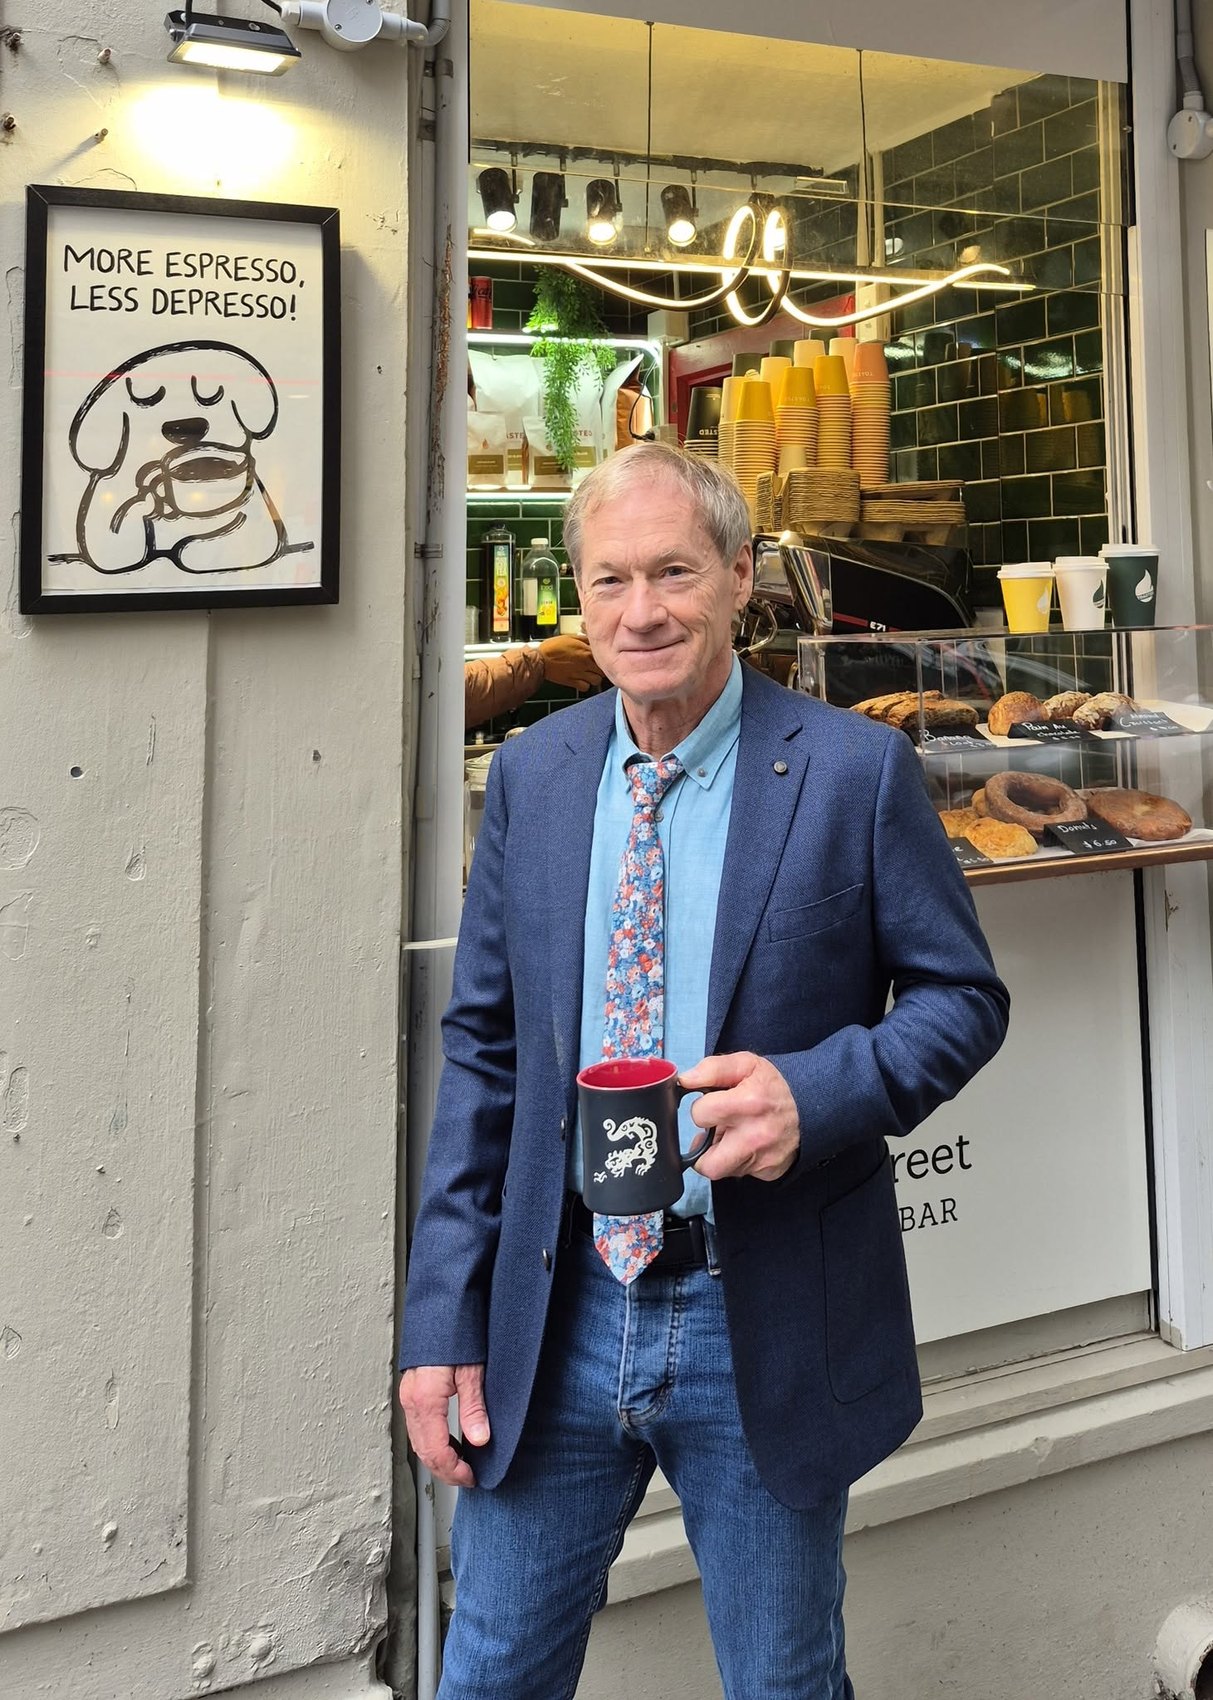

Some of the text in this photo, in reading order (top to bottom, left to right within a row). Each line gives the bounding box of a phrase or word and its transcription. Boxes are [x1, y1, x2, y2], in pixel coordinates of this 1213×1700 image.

[64, 244, 305, 288] MORE ESPRESSO,
[70, 284, 296, 321] LESS DEPRESSO!
[869, 621, 886, 632] E71
[1021, 722, 1049, 731] Pain
[1057, 821, 1098, 834] Donuts
[899, 1198, 958, 1232] BAR
